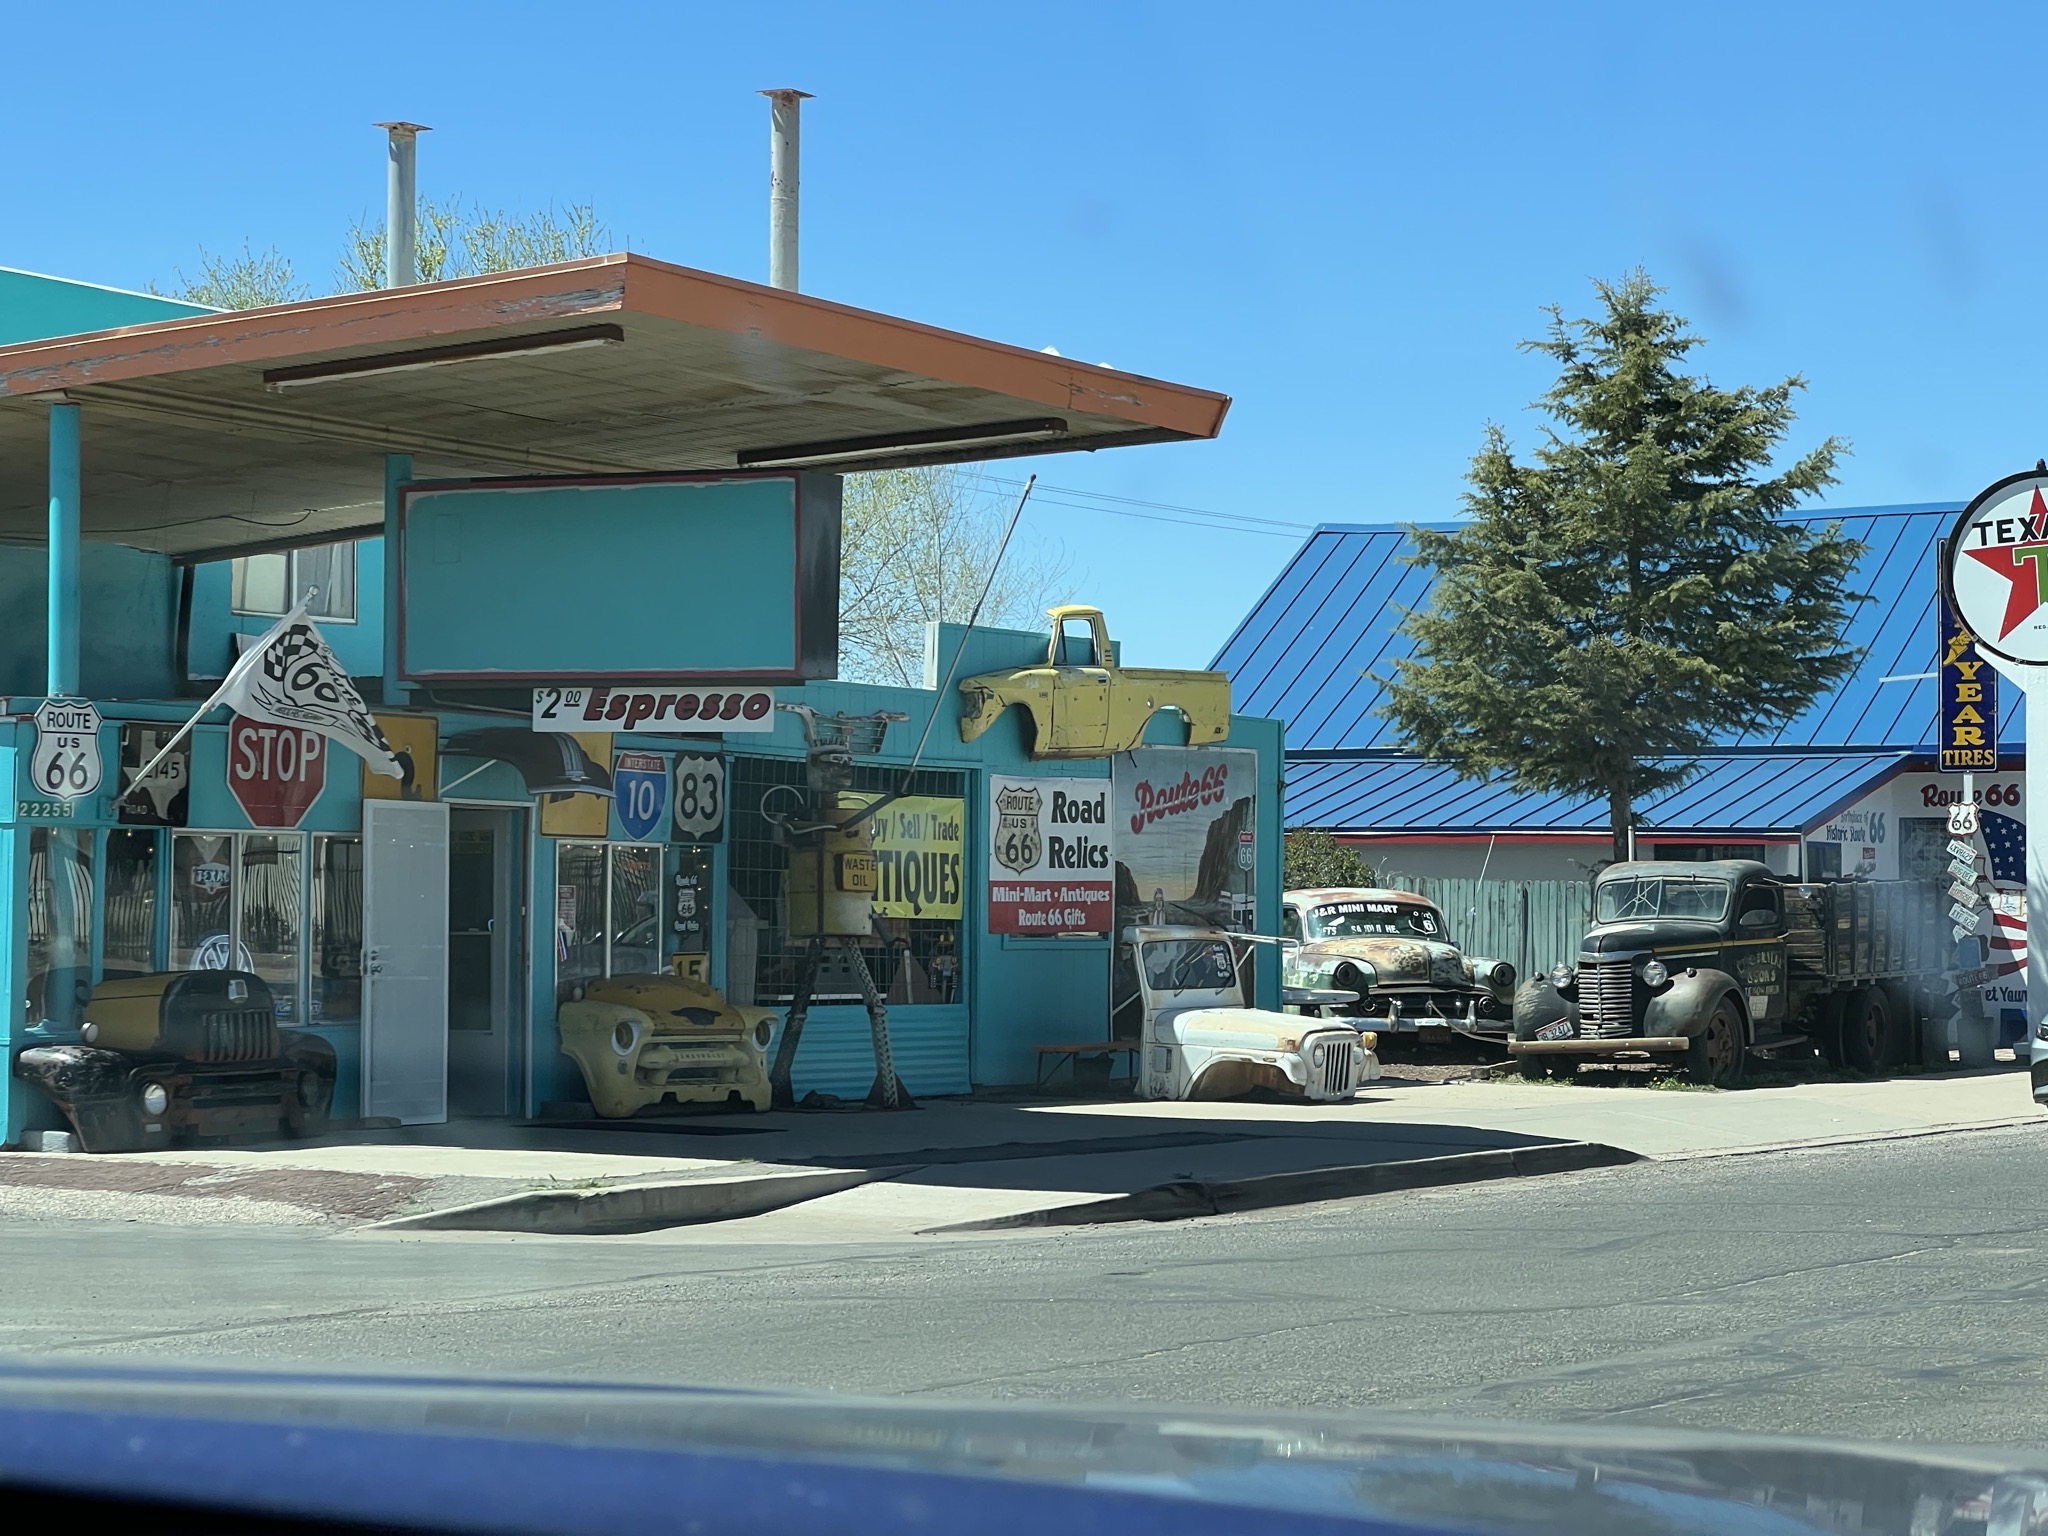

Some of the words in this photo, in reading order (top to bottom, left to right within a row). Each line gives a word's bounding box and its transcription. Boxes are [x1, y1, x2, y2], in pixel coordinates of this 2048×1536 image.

[583, 689, 771, 730] Espresso
[47, 711, 92, 730] ROUTE
[57, 737, 80, 749] US
[235, 726, 321, 782] STOP
[623, 758, 662, 770] INTERSTATE
[1942, 748, 1994, 767] TIRES
[46, 751, 88, 790] 66
[628, 780, 655, 820] 10
[681, 772, 718, 820] 83
[1006, 796, 1034, 811] ROUTE
[1920, 783, 1983, 808] Roue
[1985, 784, 2021, 806] 66
[19, 804, 73, 817] 22255
[1051, 791, 1106, 824] Road
[899, 812, 920, 840] Sell
[931, 814, 959, 842] Trade
[1011, 818, 1027, 829] US
[1869, 812, 1886, 844] 66
[1951, 807, 1973, 830] 66
[1005, 833, 1033, 864] 66
[1048, 835, 1109, 869] Relics
[1240, 847, 1252, 864] 66
[845, 857, 877, 871] WASTE
[852, 874, 869, 887] OIL
[871, 850, 959, 916] TIQUES
[992, 886, 1052, 902] Mini-Mart
[1060, 887, 1110, 905] Antiques
[681, 903, 693, 914] 66
[1312, 905, 1337, 918] J&R
[1338, 903, 1365, 914] MINI
[1366, 903, 1398, 914] MART
[1018, 909, 1047, 926] Route
[1048, 909, 1062, 925] 66
[1064, 909, 1085, 929] Gifts
